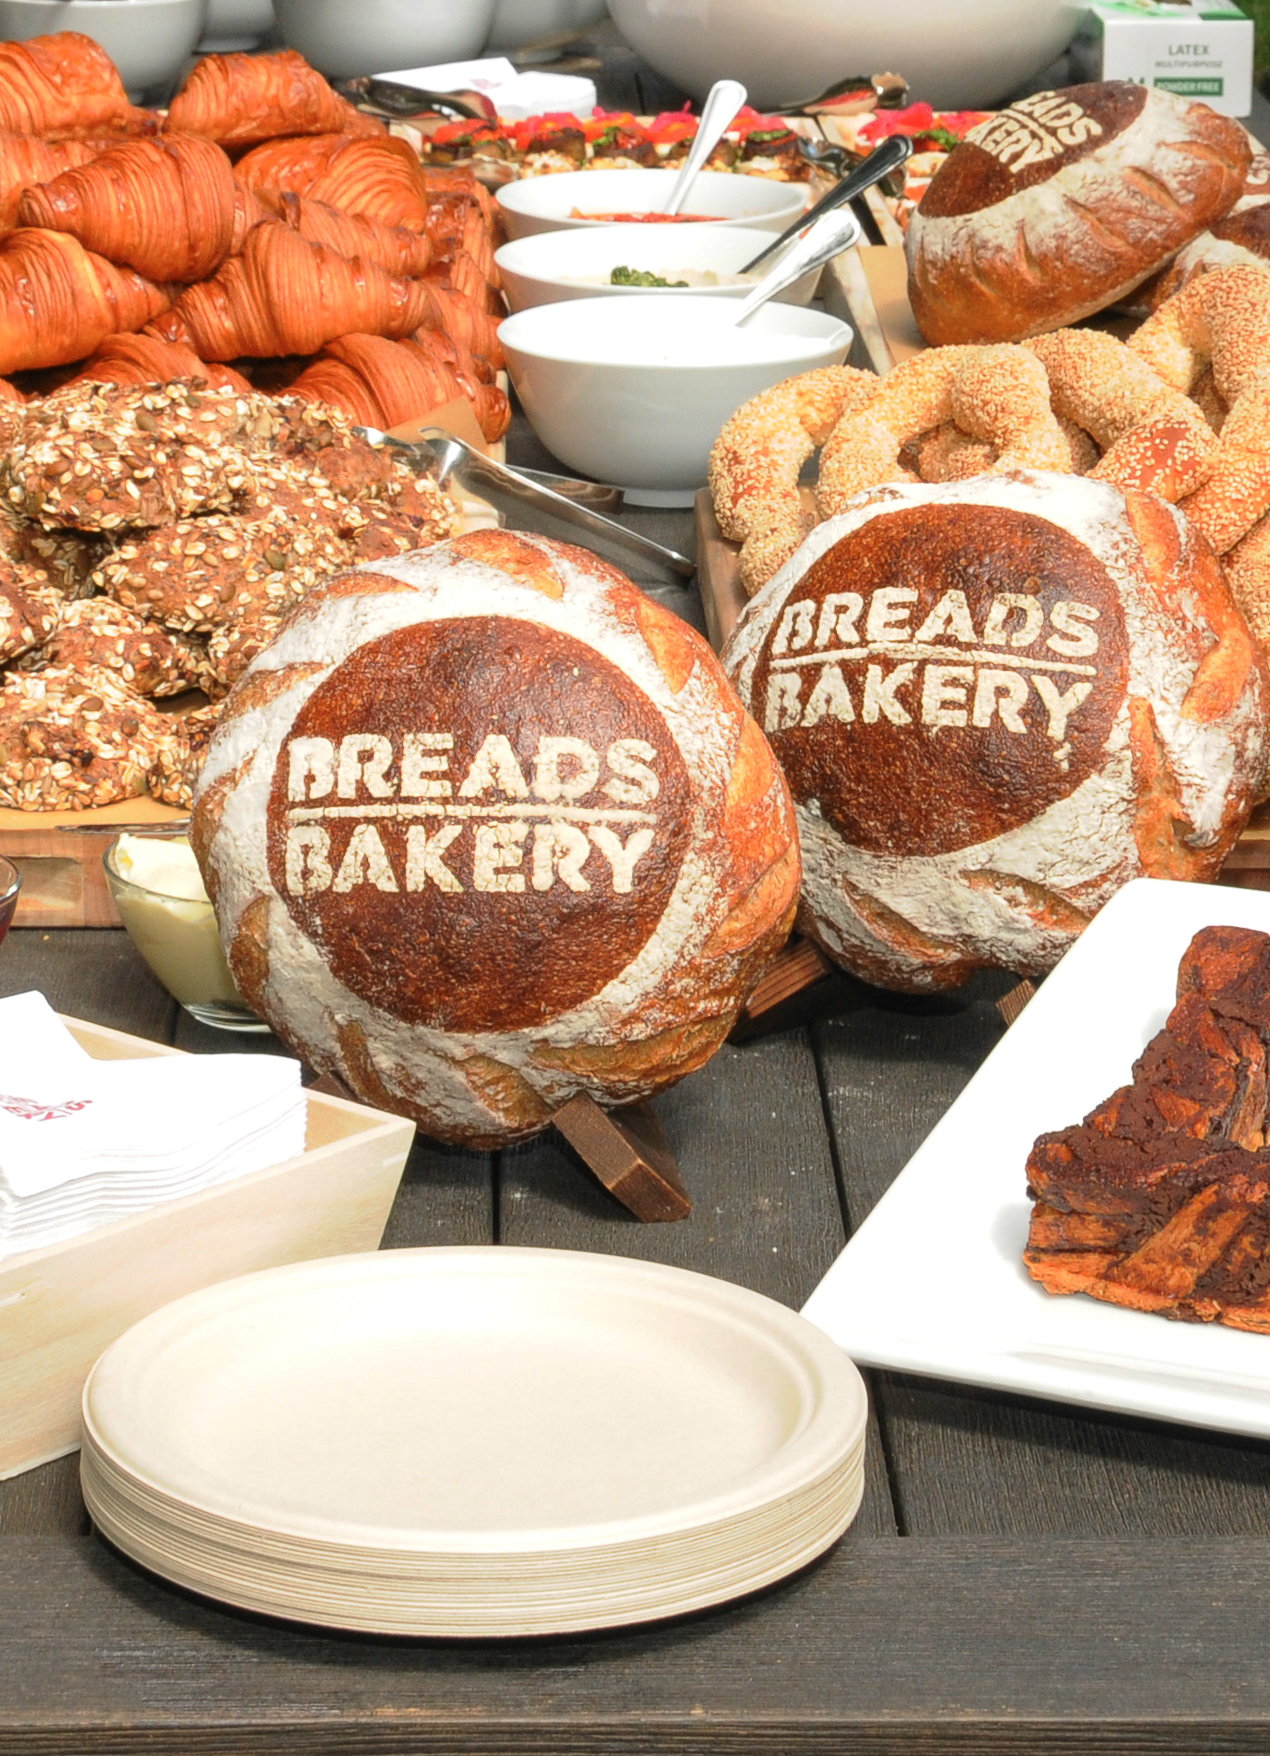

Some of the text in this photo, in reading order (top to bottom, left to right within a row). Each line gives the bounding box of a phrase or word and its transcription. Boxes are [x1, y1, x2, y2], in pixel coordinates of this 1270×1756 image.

[1168, 44, 1209, 55] LATEX
[1197, 81, 1219, 92] FREE
[771, 587, 1100, 657] BREADS
[765, 661, 1094, 741] BAKERY
[287, 732, 661, 804] BREADS
[285, 821, 655, 896] BAKERY
